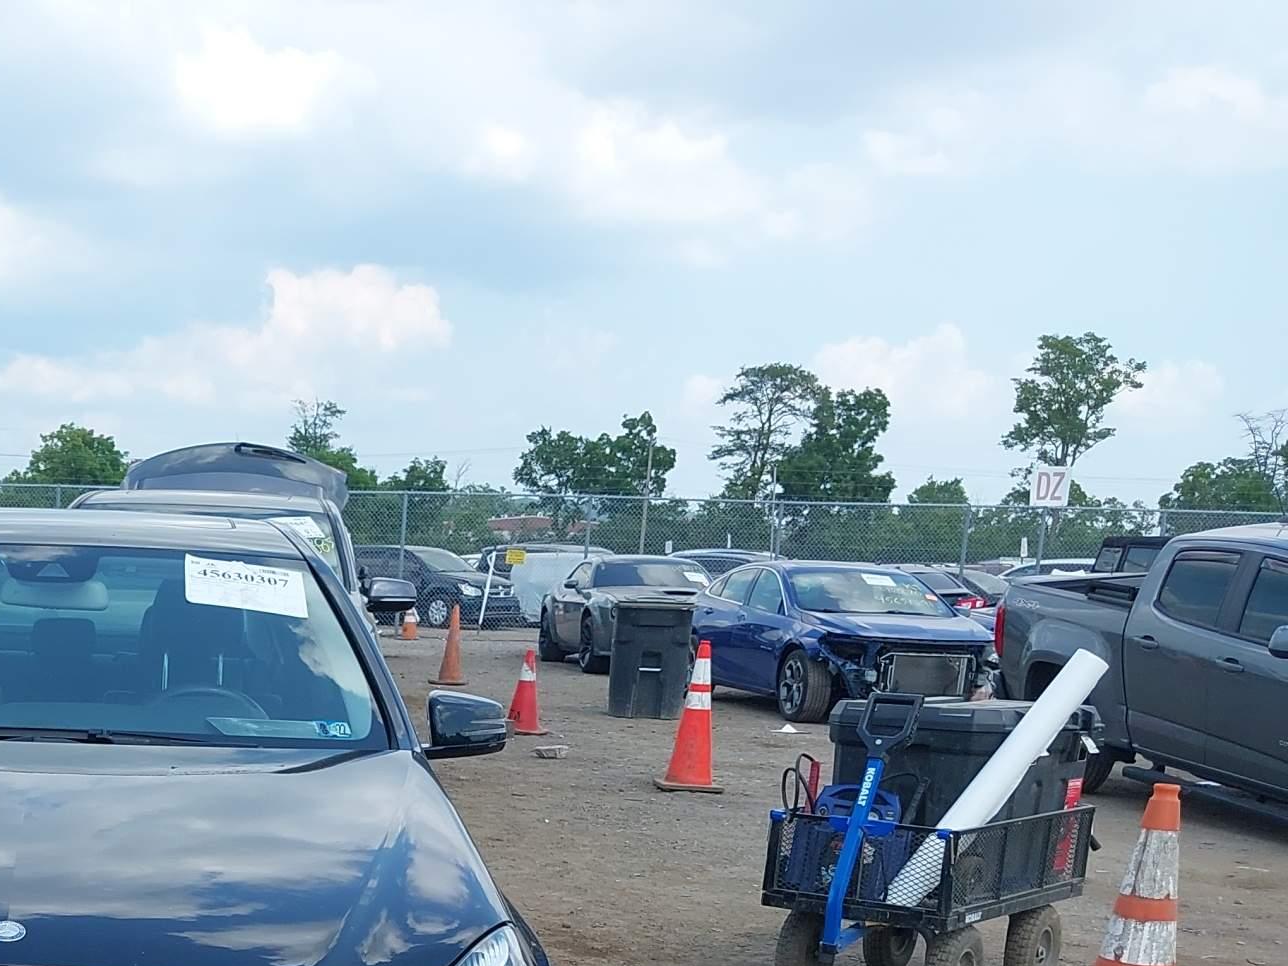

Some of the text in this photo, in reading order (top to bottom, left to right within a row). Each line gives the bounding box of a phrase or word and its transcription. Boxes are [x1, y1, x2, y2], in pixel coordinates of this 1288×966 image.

[1036, 471, 1066, 501] DZ
[197, 568, 289, 588] 45630307
[857, 767, 876, 807] KOBALT
